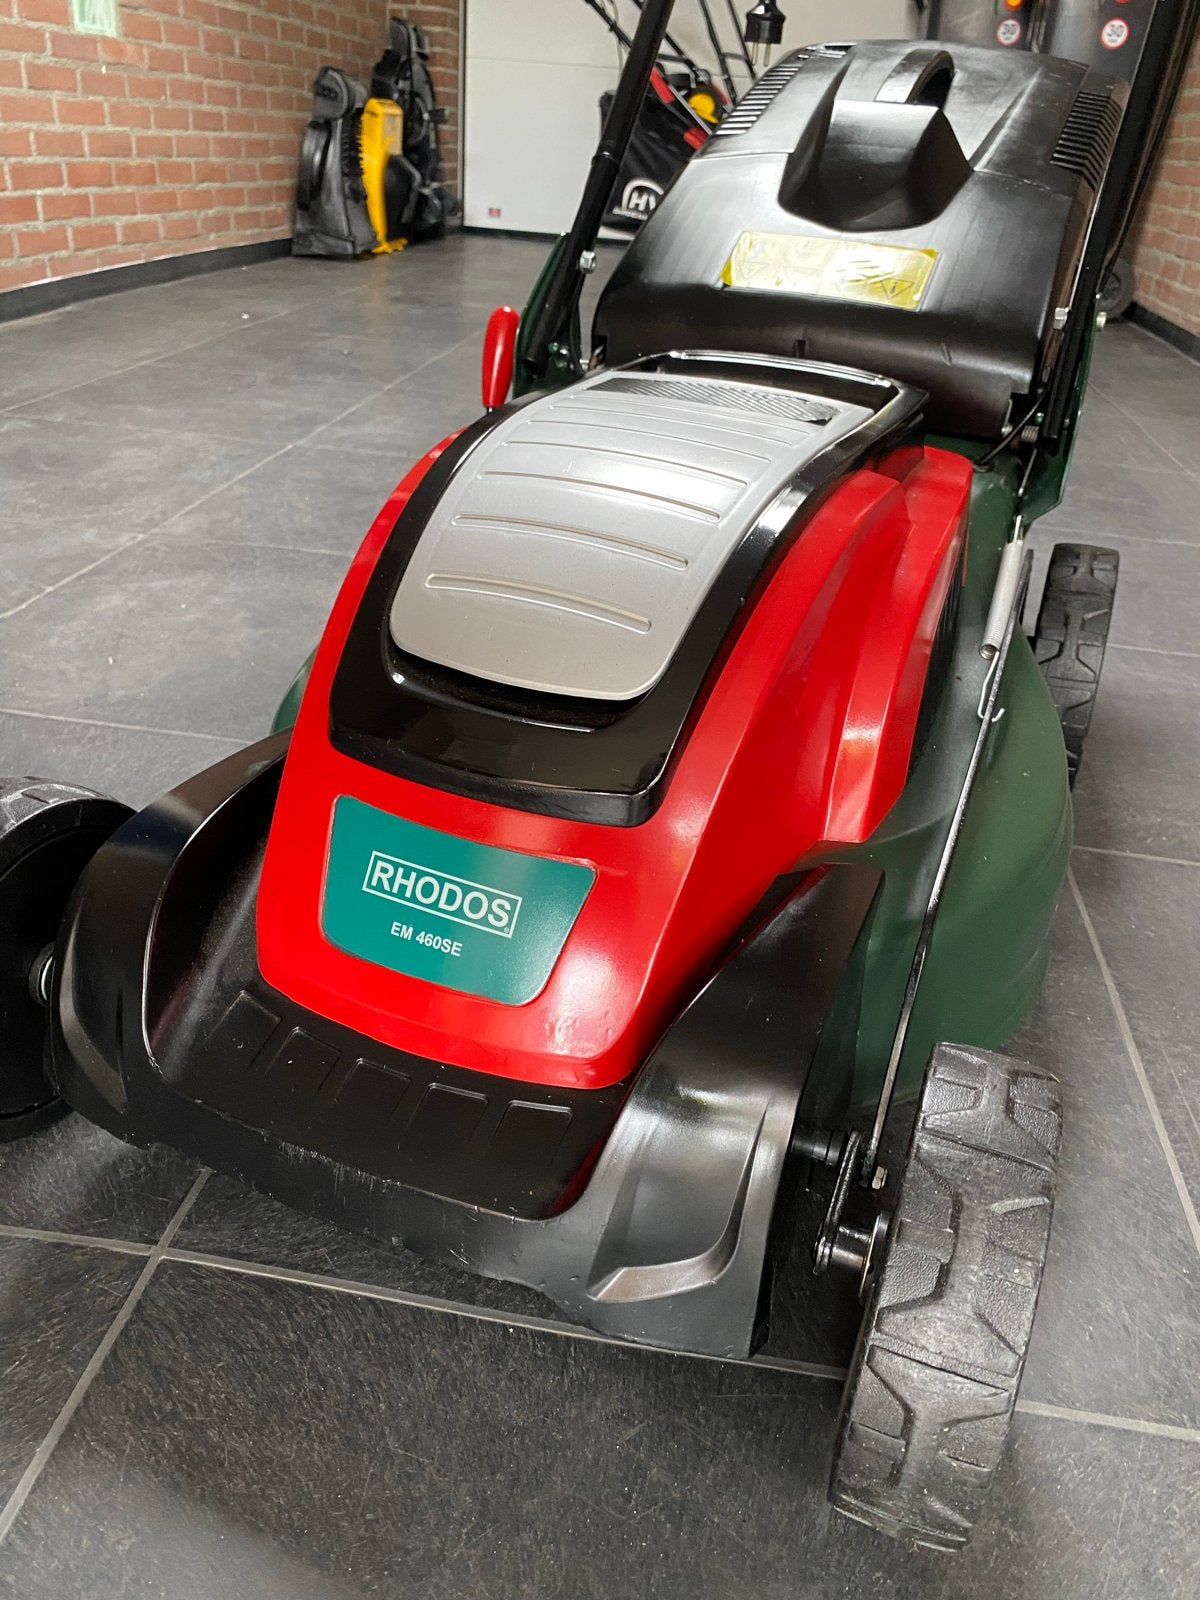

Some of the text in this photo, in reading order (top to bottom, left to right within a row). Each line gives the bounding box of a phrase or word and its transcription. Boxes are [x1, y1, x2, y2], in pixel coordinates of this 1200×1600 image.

[370, 860, 512, 929] RHODOS
[390, 921, 463, 957] EM 460SE
